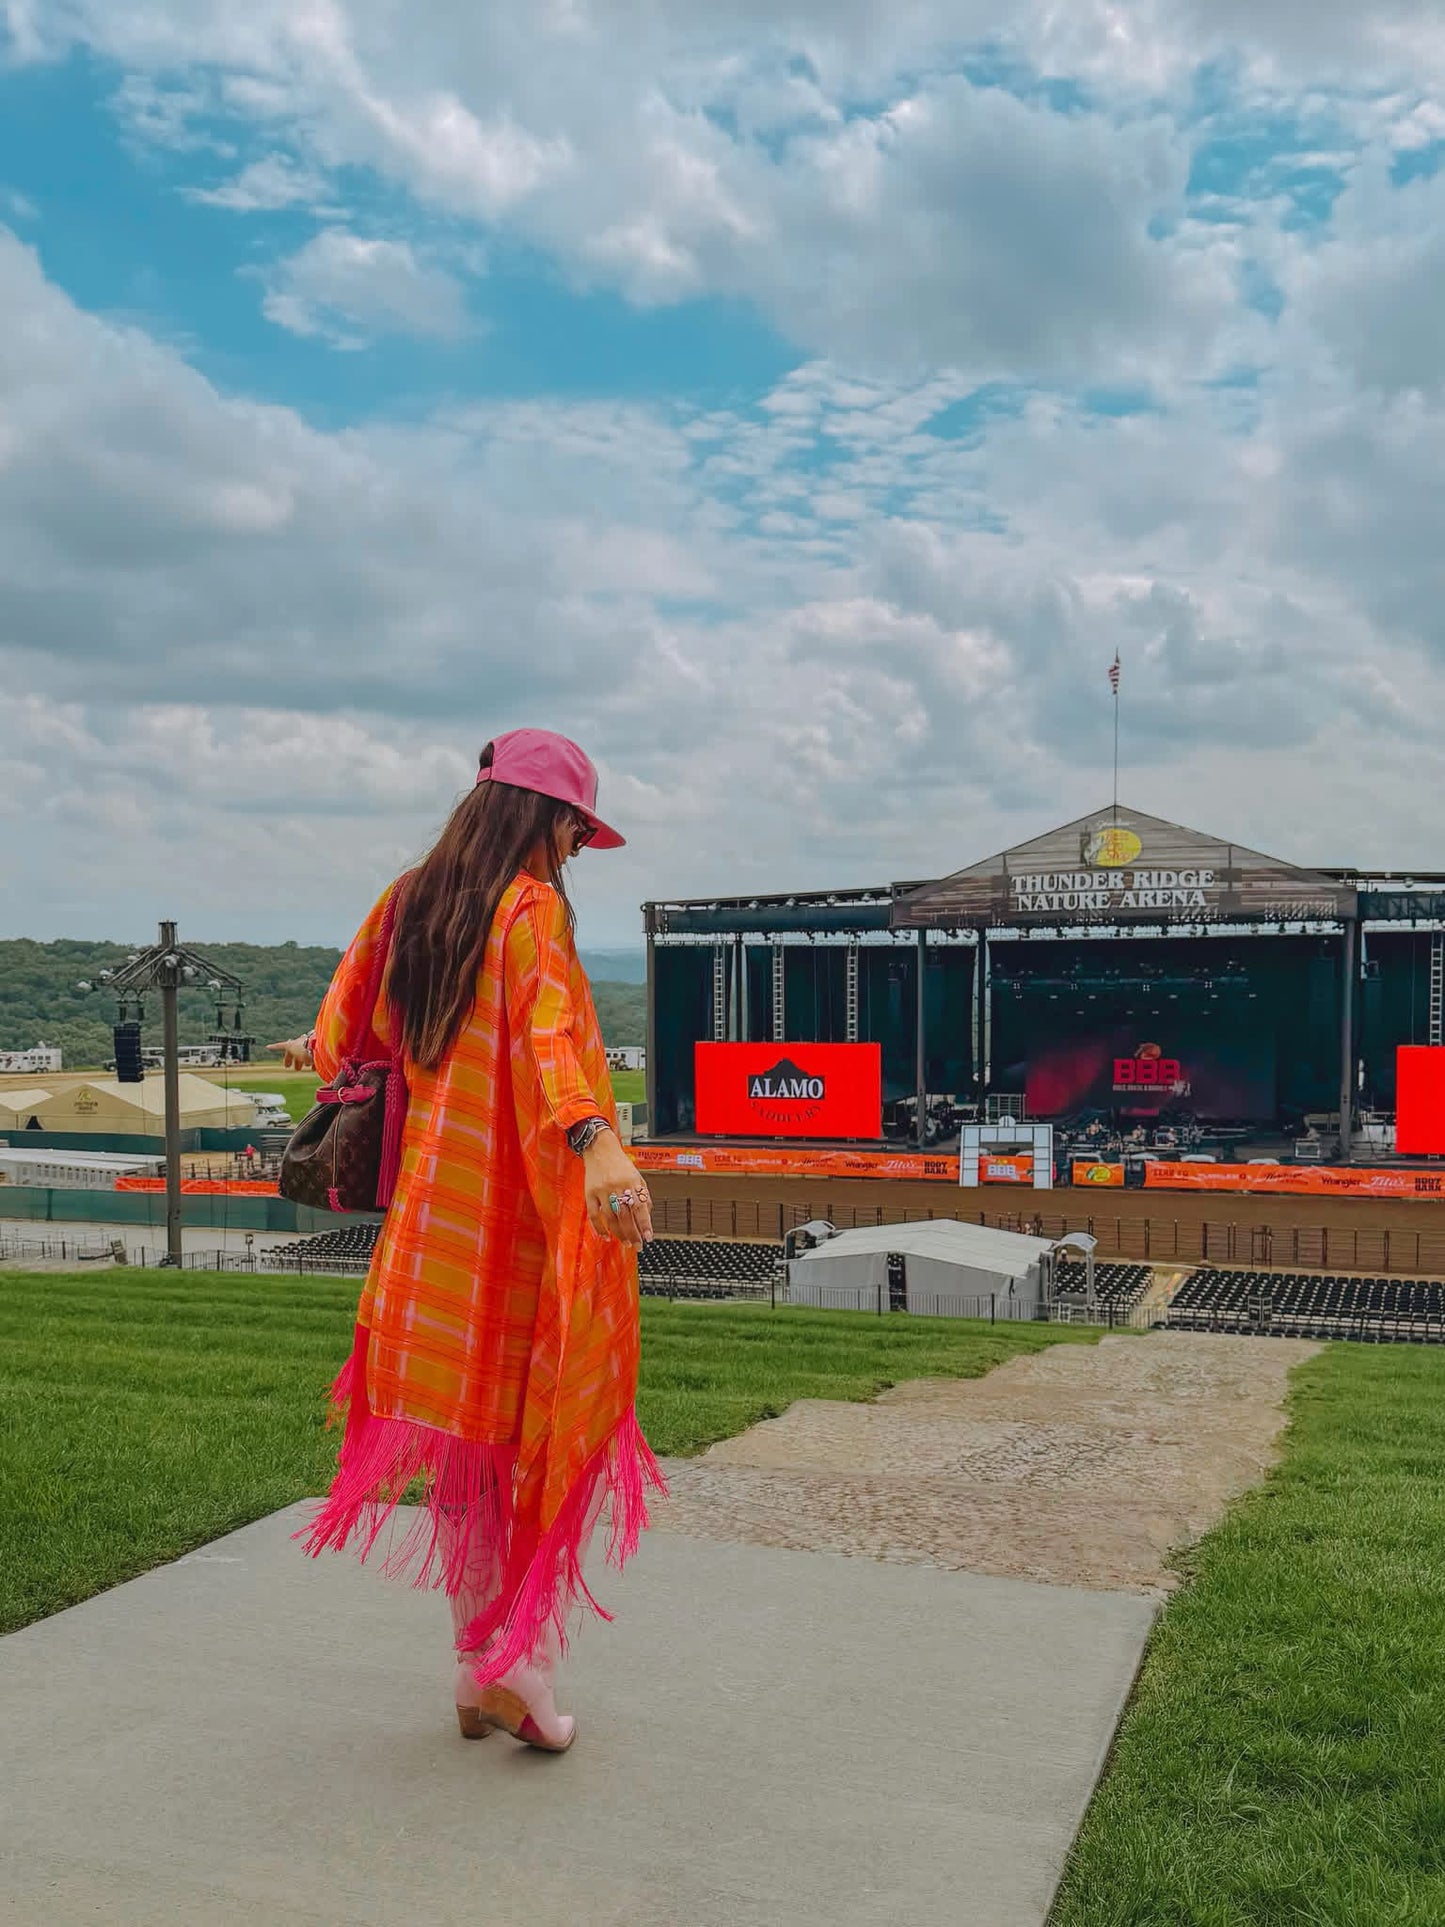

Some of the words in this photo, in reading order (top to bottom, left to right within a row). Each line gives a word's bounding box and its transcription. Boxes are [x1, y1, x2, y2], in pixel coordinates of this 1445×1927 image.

[1011, 871, 1125, 893] THUNDER
[1133, 869, 1215, 889] RIDGE
[1016, 892, 1112, 911] NATURE
[1119, 889, 1207, 908] ARENA
[1113, 1058, 1180, 1084] BBB
[750, 1078, 824, 1099] ALAMO
[1321, 1176, 1361, 1188] Wrangler
